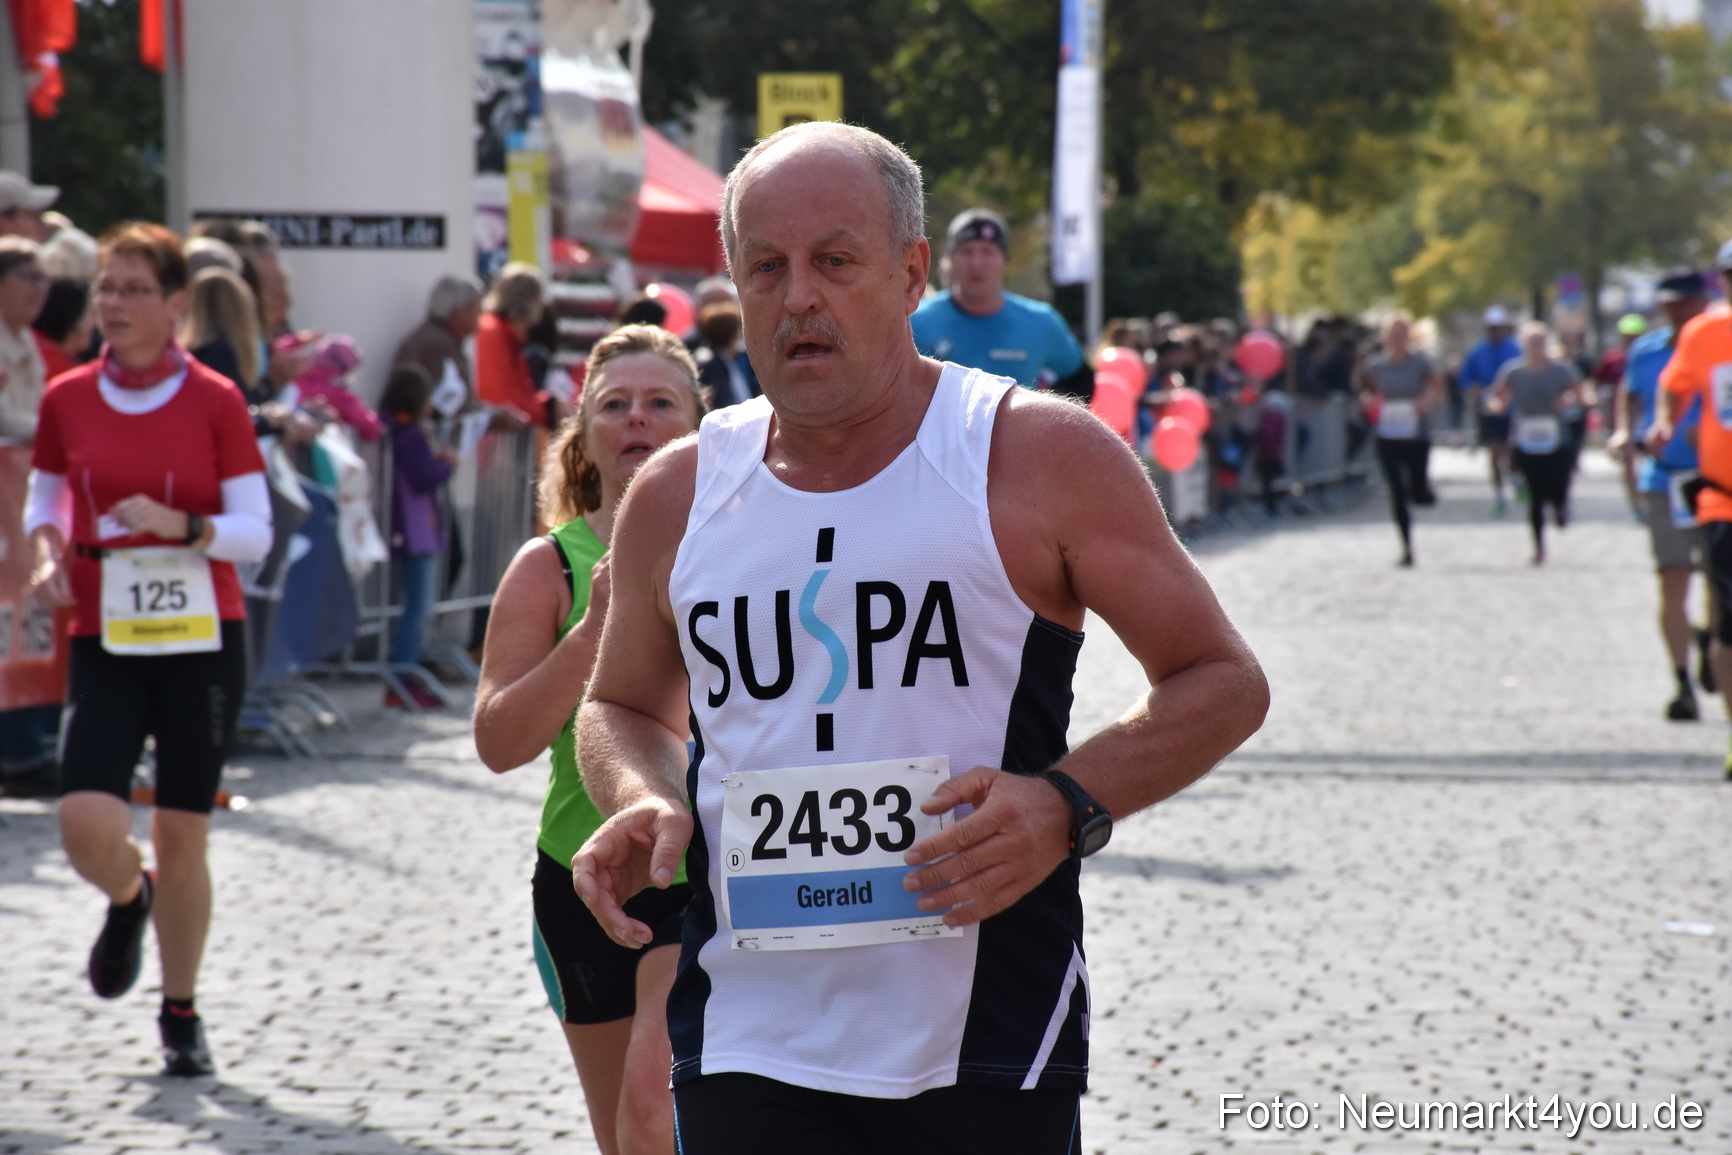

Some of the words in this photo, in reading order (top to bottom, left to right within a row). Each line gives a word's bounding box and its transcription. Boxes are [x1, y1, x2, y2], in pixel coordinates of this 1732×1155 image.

[126, 580, 188, 612] 125
[688, 570, 969, 708] SUSPA
[750, 785, 916, 860] 2433
[797, 880, 873, 908] Gerald
